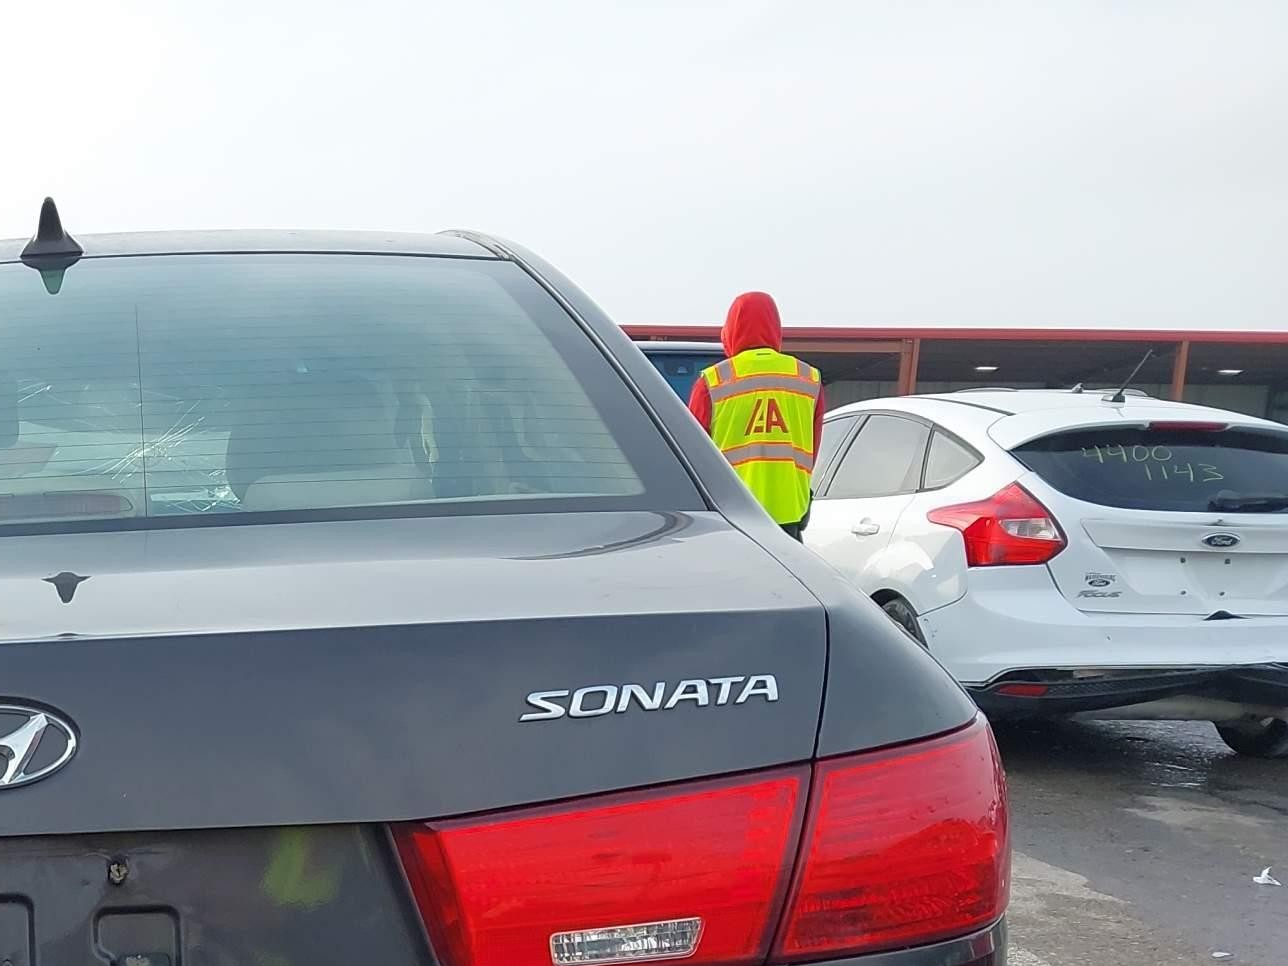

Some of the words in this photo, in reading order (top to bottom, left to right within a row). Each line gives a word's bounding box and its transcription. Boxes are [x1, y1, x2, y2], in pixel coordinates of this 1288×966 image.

[1082, 444, 1172, 463] 4400
[1145, 463, 1224, 482] 1143
[519, 674, 779, 722] SONATA
